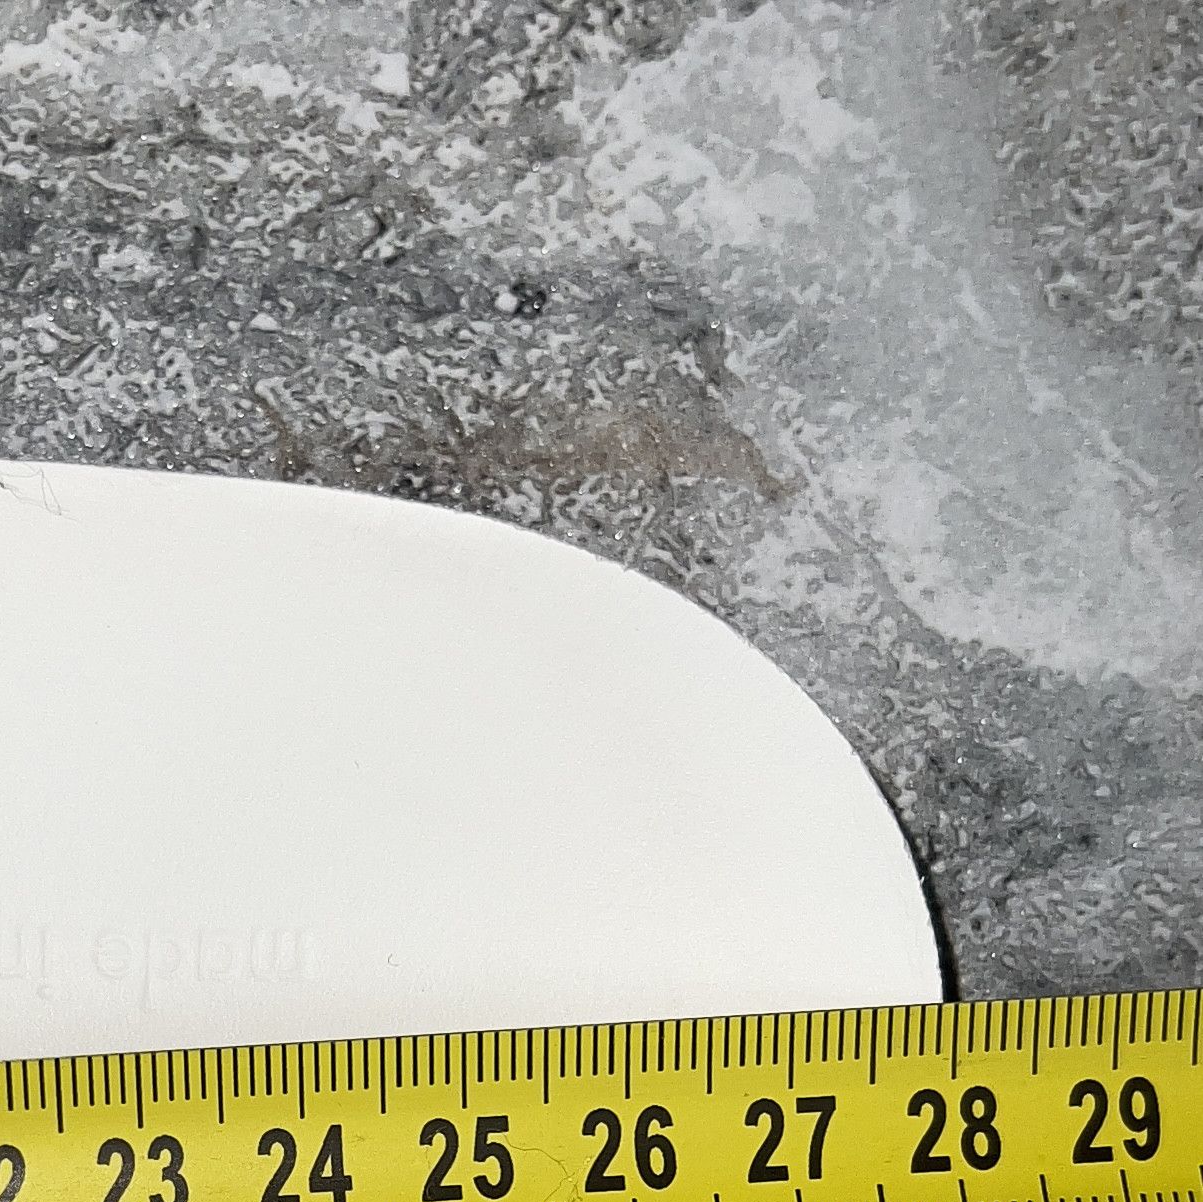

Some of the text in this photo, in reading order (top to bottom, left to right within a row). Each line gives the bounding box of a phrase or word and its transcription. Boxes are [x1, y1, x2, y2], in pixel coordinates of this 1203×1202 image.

[92, 922, 320, 1014] made
[419, 1116, 515, 1202] 25
[581, 1105, 677, 1193] 26
[744, 1096, 837, 1184] 27
[907, 1086, 1002, 1174] 28
[1068, 1077, 1161, 1164] 29
